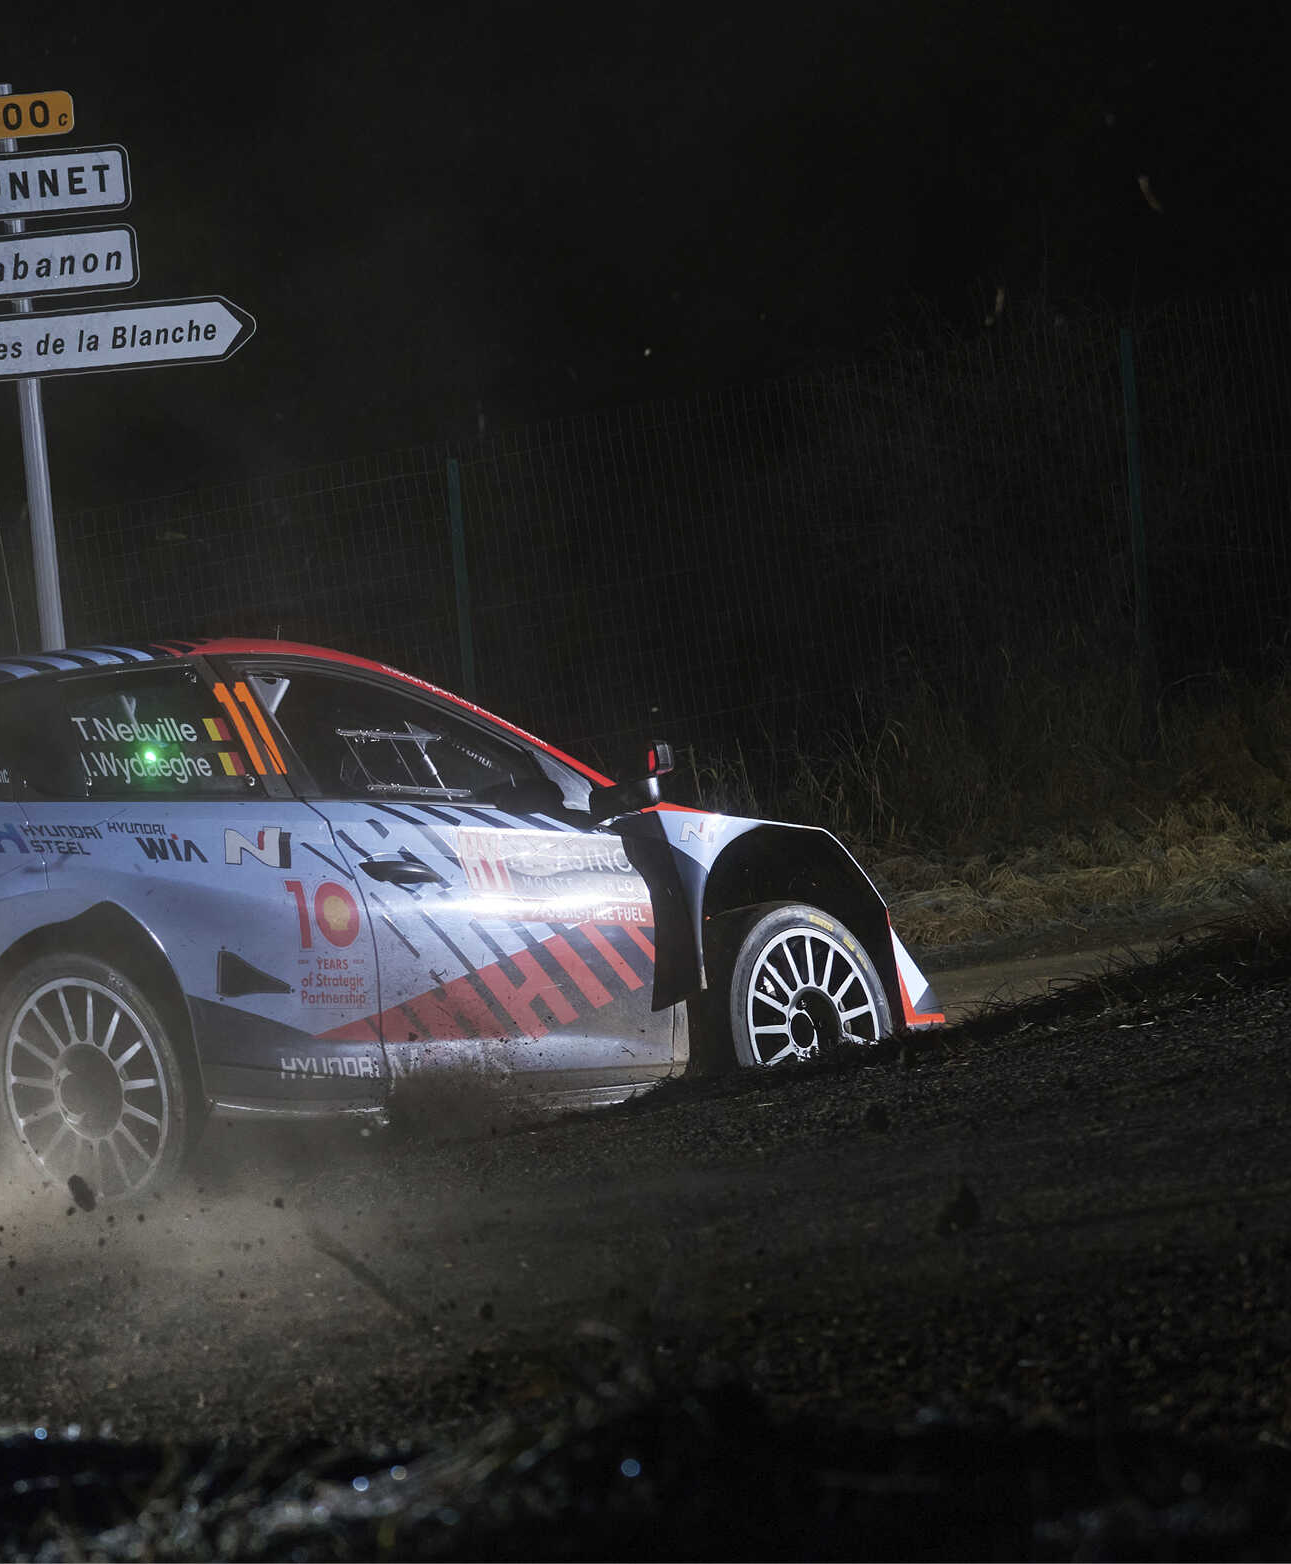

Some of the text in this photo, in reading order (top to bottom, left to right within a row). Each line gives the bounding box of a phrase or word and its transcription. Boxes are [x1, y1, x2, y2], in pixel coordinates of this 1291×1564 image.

[36, 331, 66, 356] de
[77, 329, 100, 353] la
[111, 319, 218, 350] Blanche
[212, 681, 288, 775] 11
[20, 824, 104, 840] HYUNDAI
[108, 821, 167, 836] HYUNDAI
[29, 839, 92, 856] STEEL
[617, 905, 648, 922] FUEL
[316, 957, 349, 970] YEARS
[301, 970, 364, 991] of Strategic
[301, 989, 366, 1007] Partnership
[280, 1056, 381, 1079] HYUNDAI
